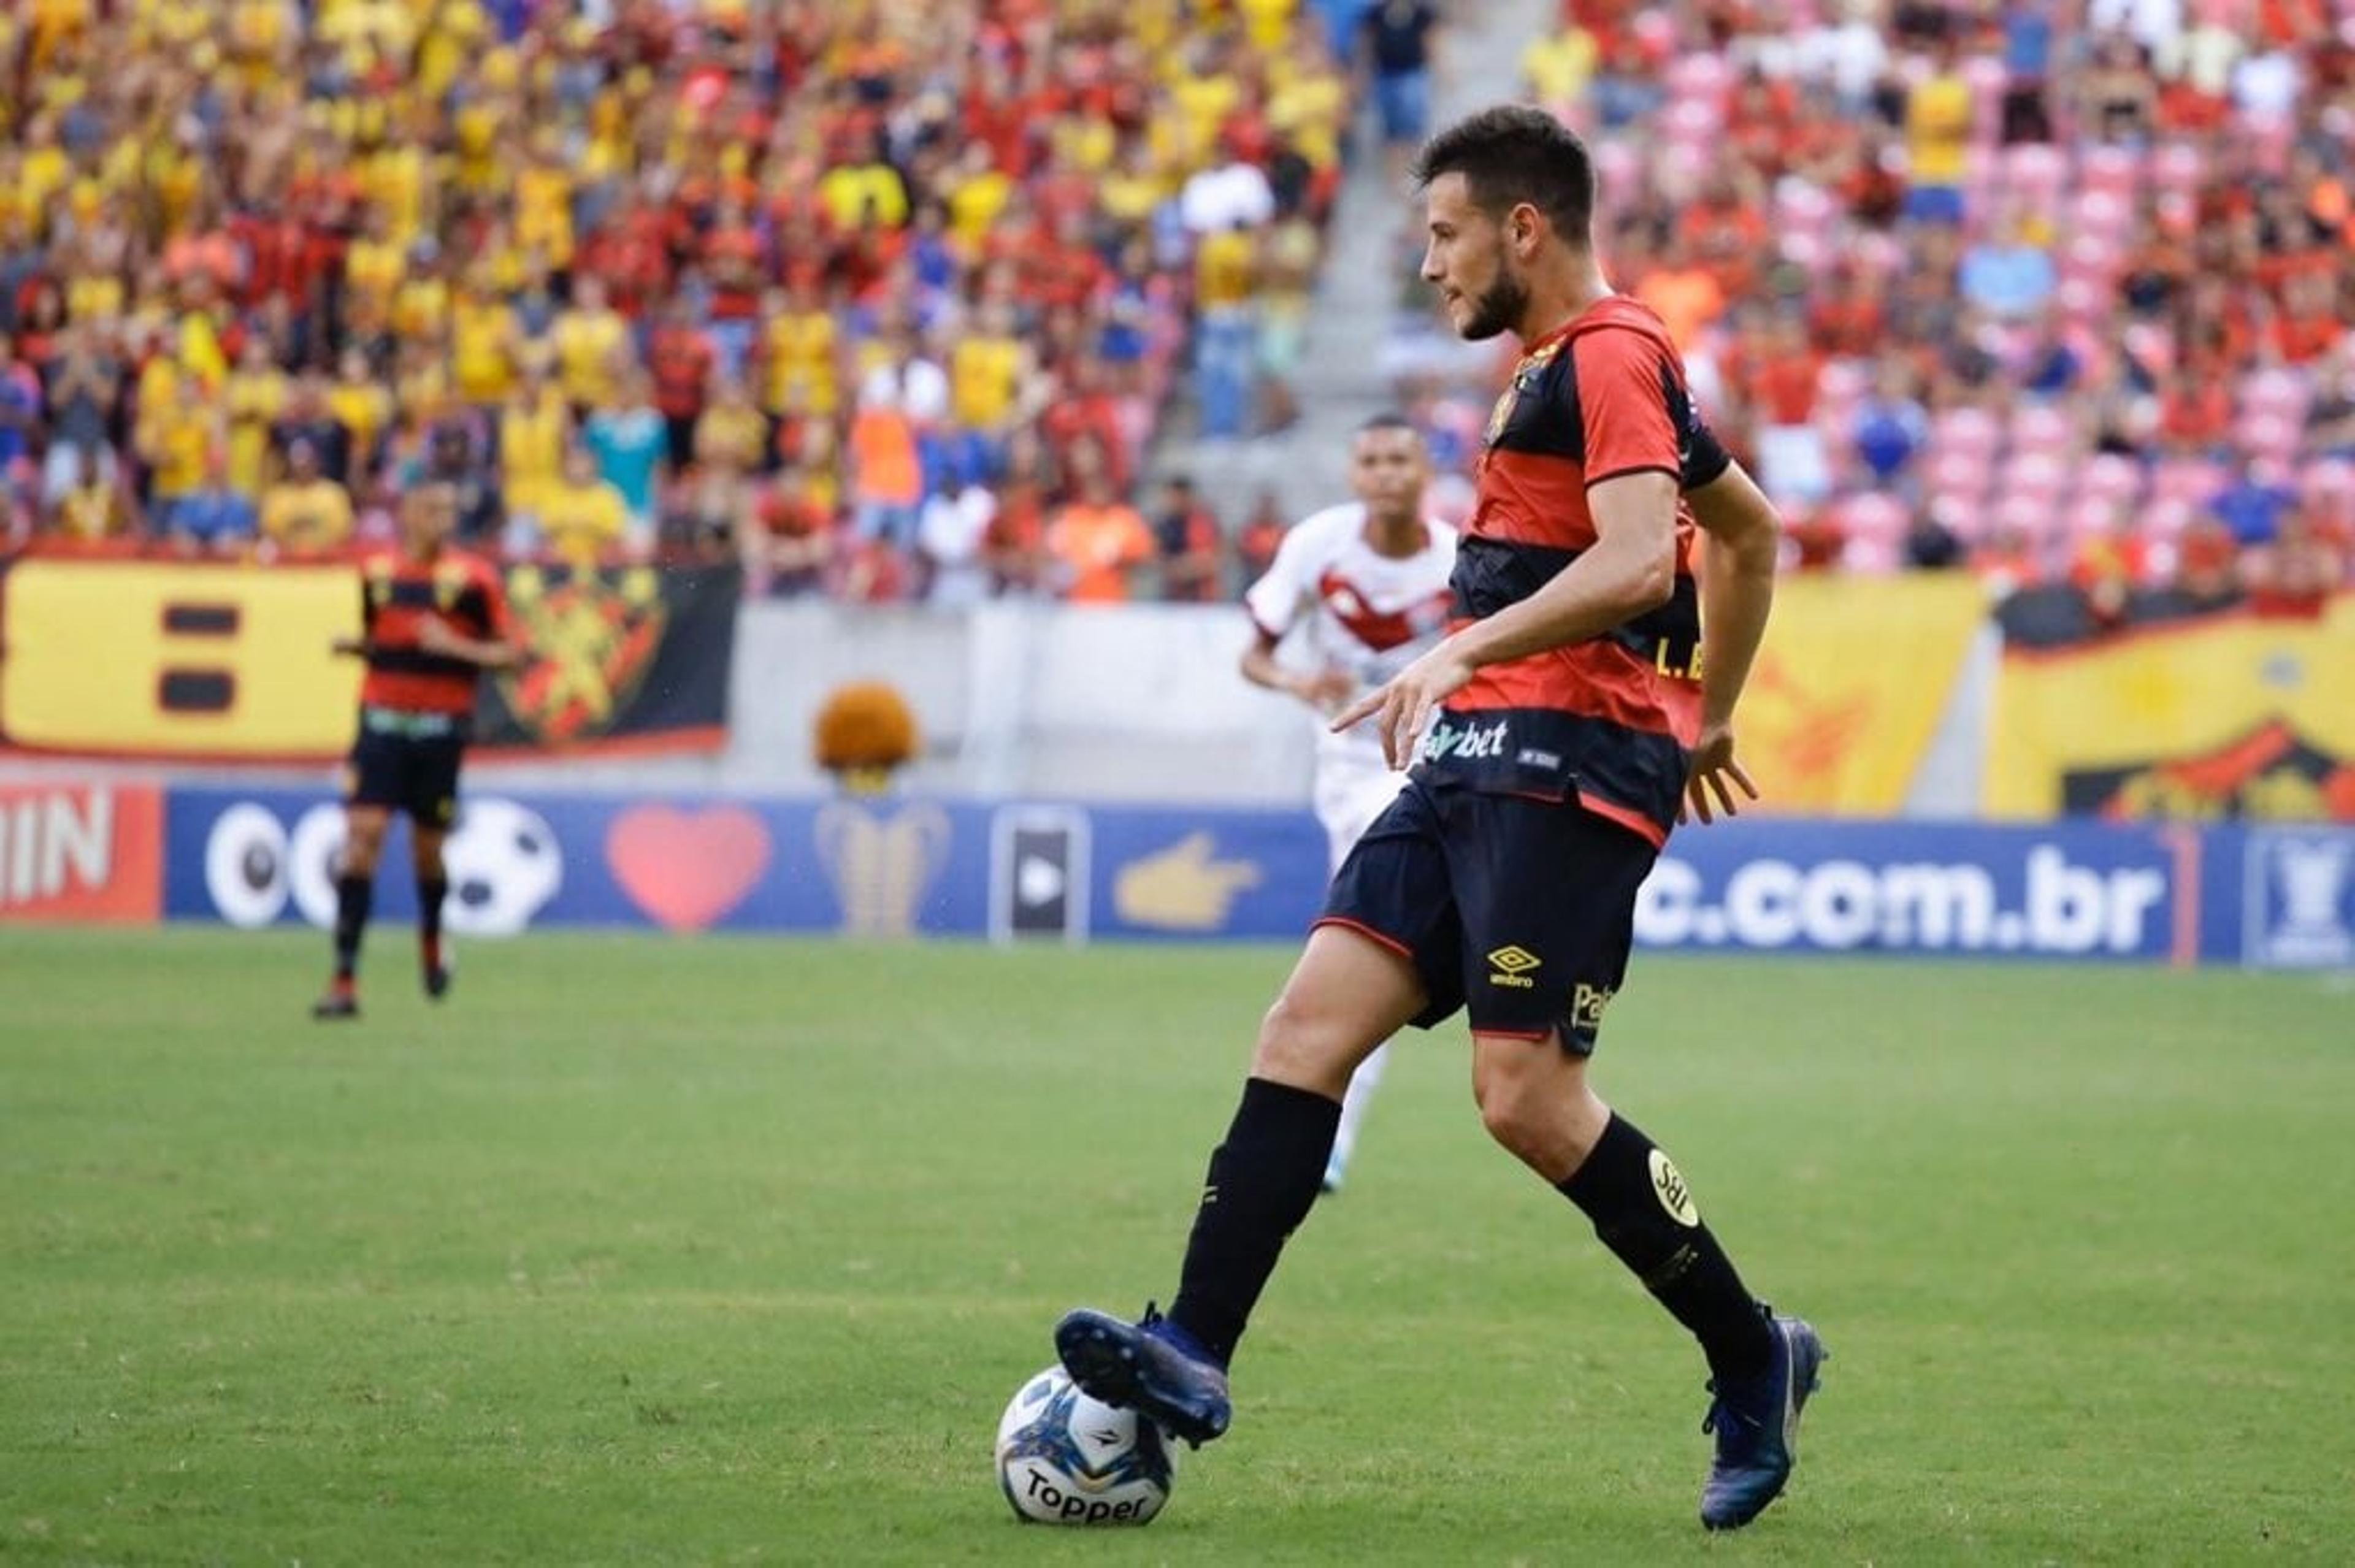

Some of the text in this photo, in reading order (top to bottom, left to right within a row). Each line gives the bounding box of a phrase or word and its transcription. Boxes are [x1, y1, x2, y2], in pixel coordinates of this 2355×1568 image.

[0, 785, 113, 900] IN
[1490, 973, 1534, 988] umbro
[1028, 1468, 1148, 1524] Topper
